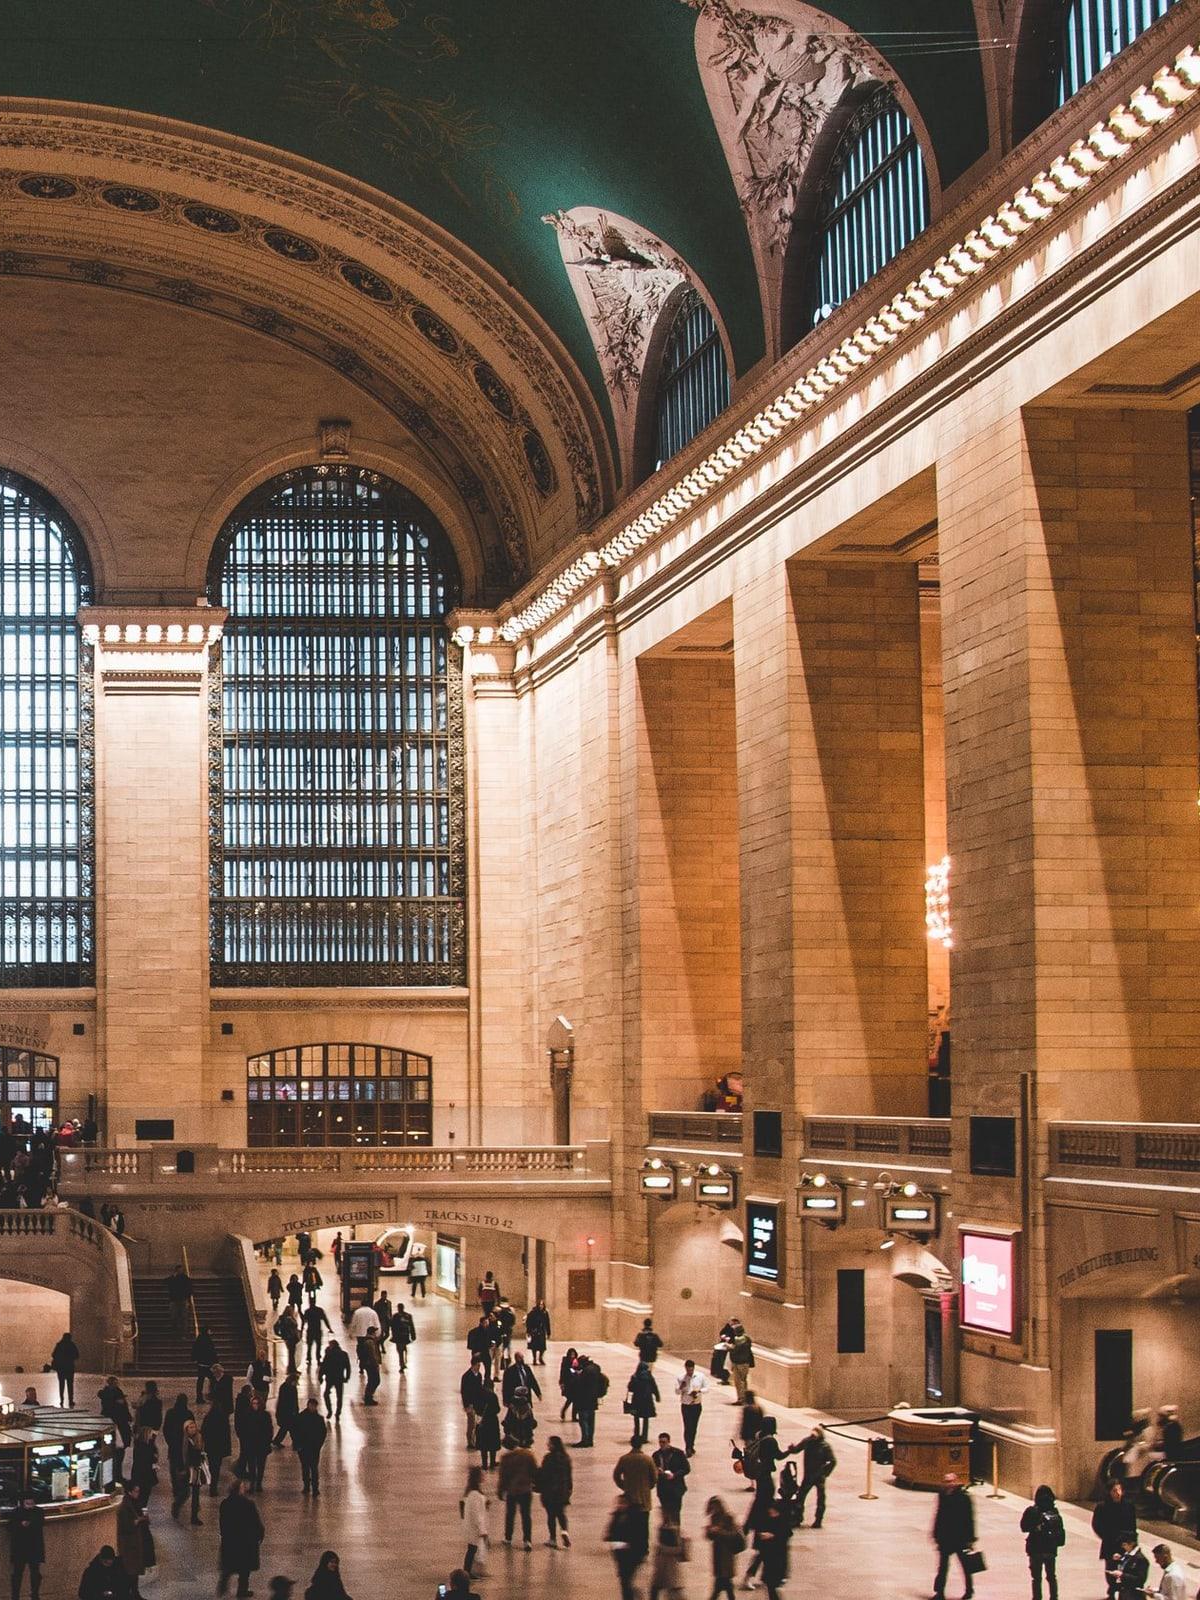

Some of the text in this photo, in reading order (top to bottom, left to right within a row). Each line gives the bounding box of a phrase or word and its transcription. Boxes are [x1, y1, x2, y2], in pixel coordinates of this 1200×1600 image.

[282, 1210, 385, 1232] TICKET MACHINES
[424, 1210, 514, 1229] TRACKS 31 TO 42
